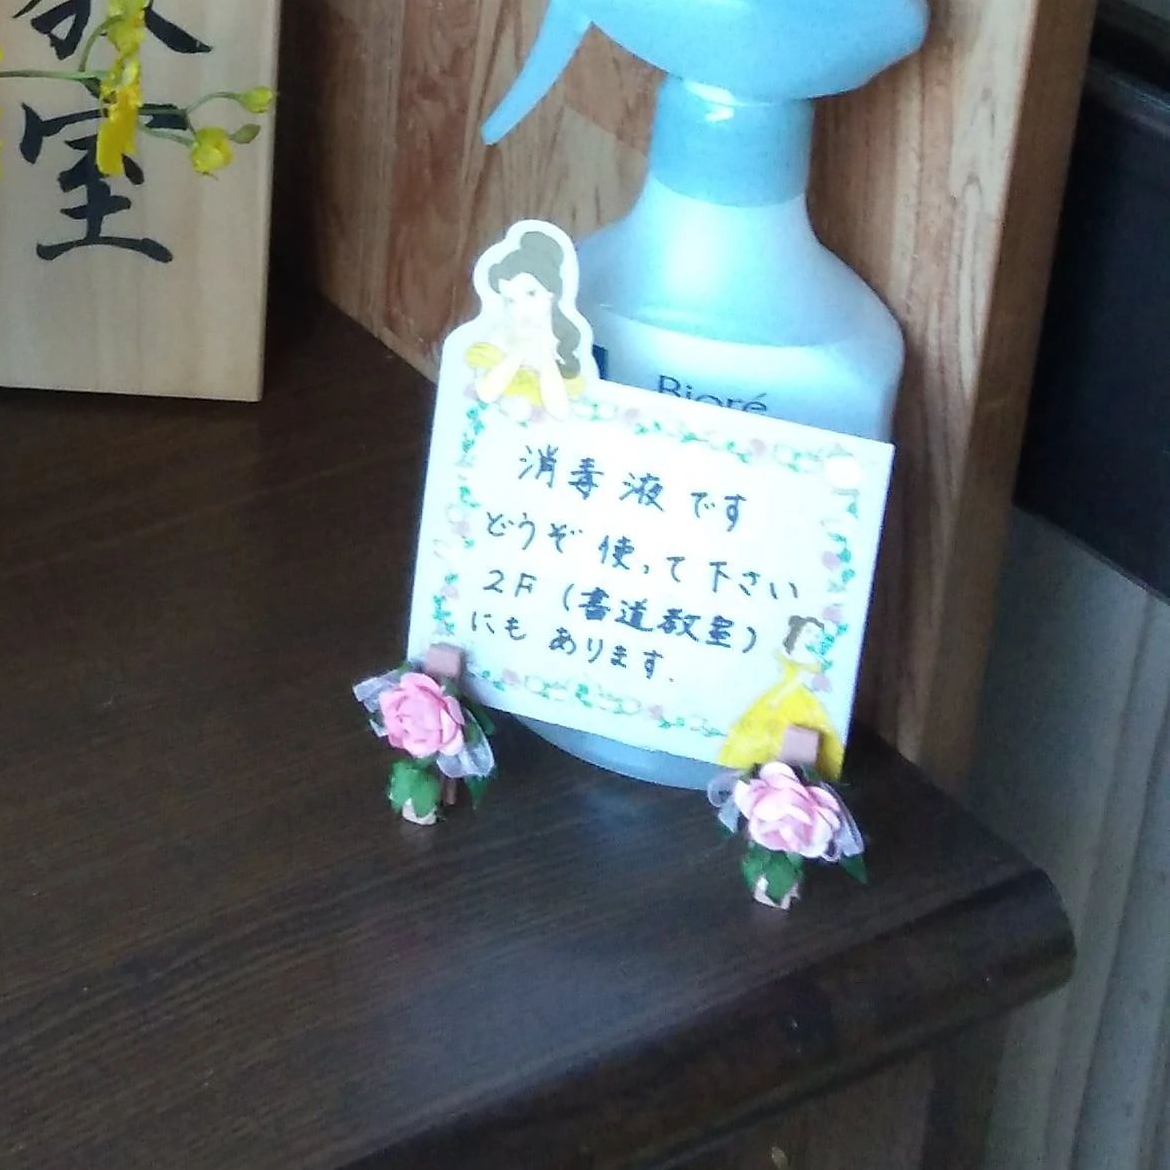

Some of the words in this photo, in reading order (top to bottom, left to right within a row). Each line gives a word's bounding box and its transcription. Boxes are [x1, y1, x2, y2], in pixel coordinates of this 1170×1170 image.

[517, 443, 747, 532] 消毒液です
